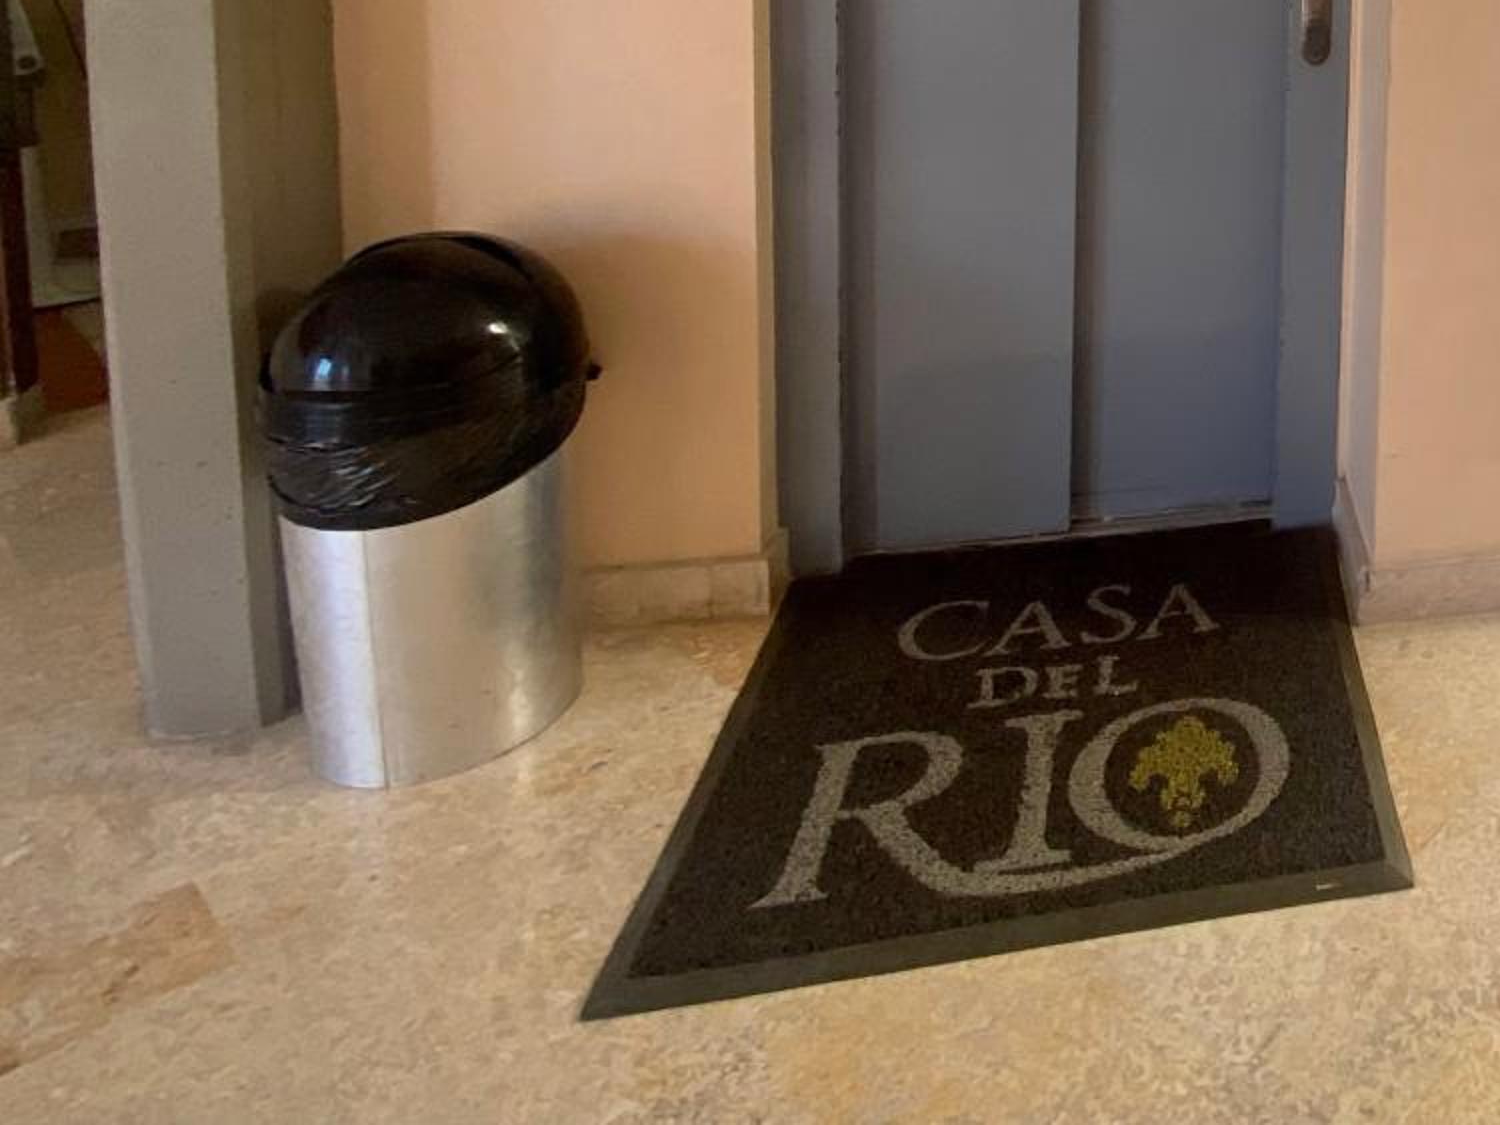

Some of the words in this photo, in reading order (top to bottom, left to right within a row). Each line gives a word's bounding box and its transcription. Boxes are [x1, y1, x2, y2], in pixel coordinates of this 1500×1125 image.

[896, 582, 1221, 662] CASA
[967, 656, 1140, 710] DEL
[747, 696, 1291, 910] RIO
